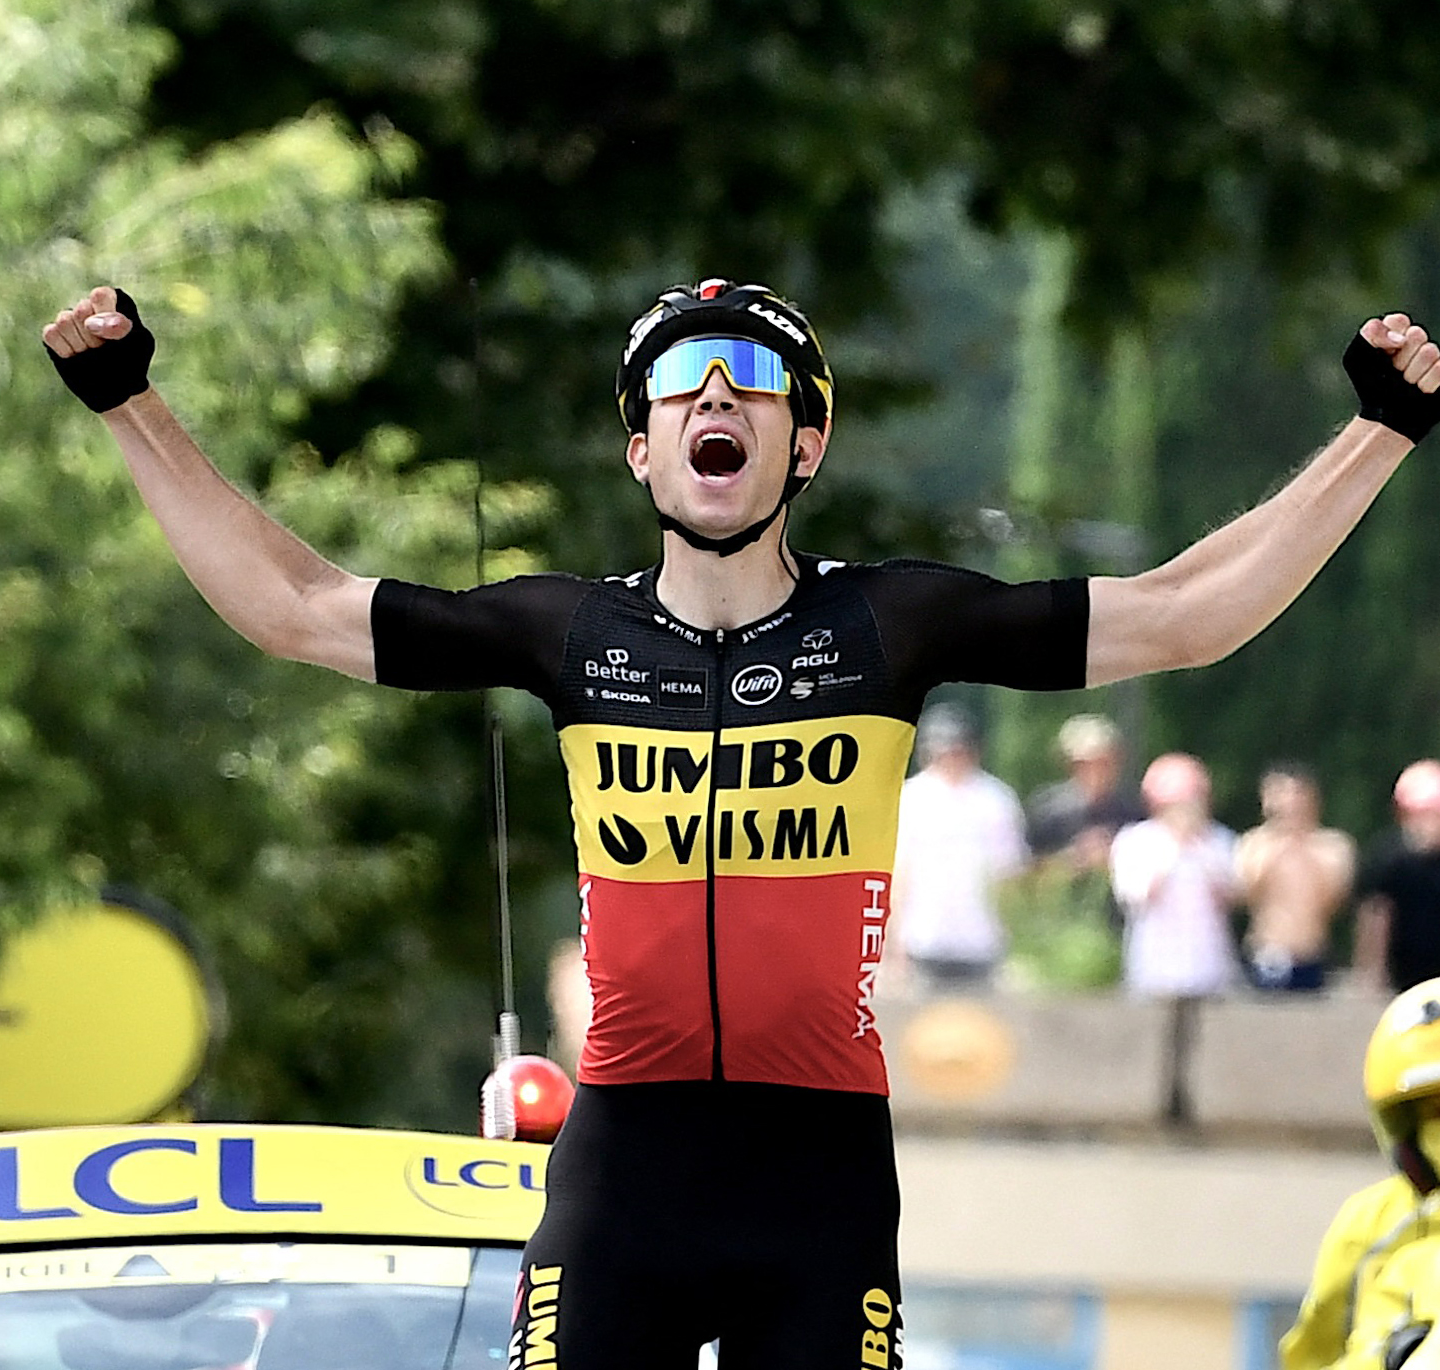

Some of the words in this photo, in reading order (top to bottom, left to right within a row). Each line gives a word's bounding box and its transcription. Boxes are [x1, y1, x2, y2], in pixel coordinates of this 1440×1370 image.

[585, 660, 650, 683] Better
[792, 652, 839, 670] AGU
[661, 682, 702, 695] HEMA
[597, 733, 859, 794] JUMBO
[664, 805, 850, 865] VISMA
[851, 878, 886, 1039] HEMA
[423, 1156, 546, 1191] LCL
